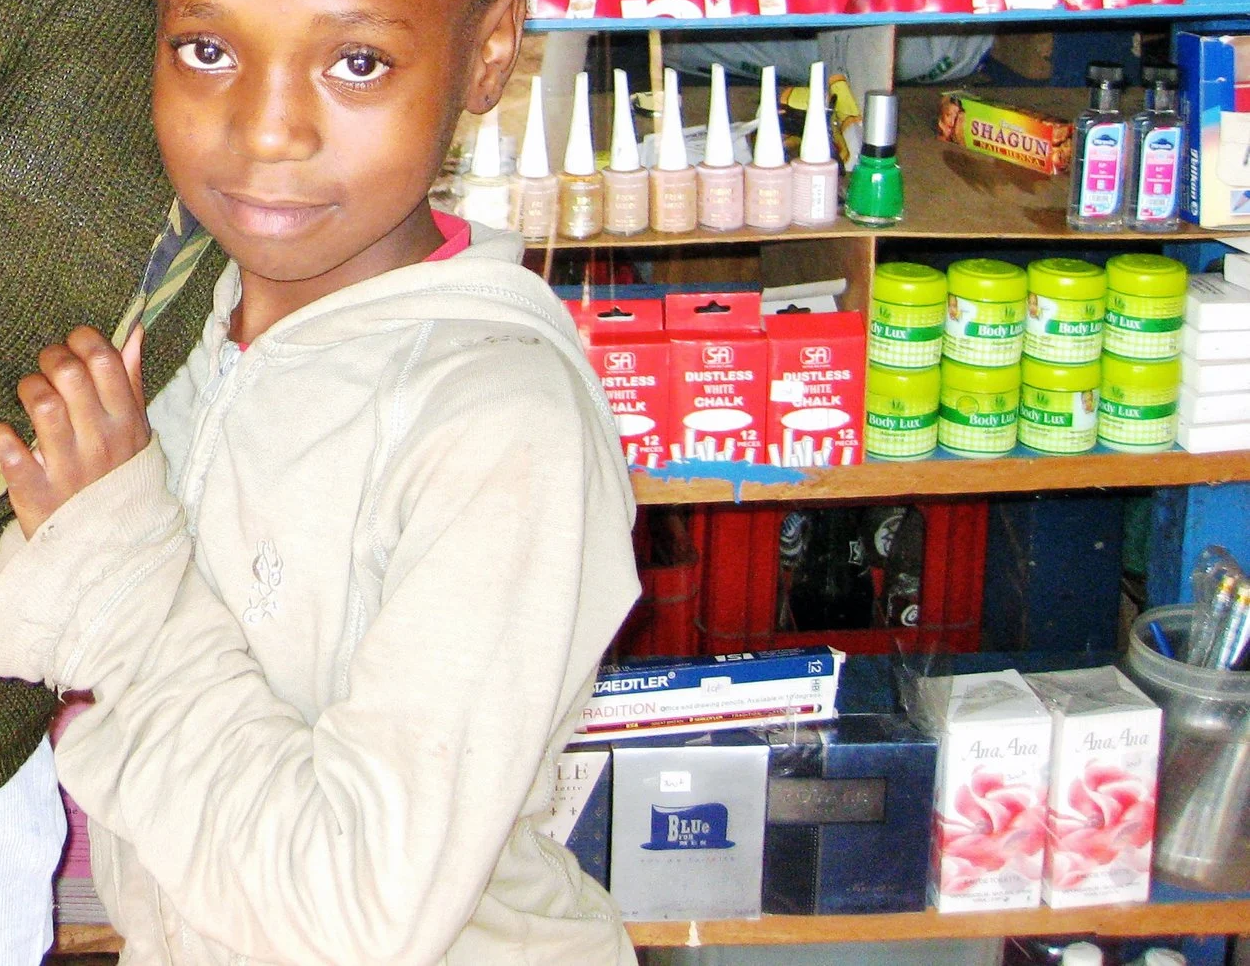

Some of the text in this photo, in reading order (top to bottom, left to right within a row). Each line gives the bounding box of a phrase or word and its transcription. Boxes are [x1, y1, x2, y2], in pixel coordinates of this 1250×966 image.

[971, 120, 1049, 156] SHAGUN
[1190, 148, 1199, 200] Pelikan
[1058, 321, 1102, 335] Body Lu
[1119, 315, 1142, 330] Lux
[885, 327, 907, 339] Lux
[978, 324, 1006, 338] Body
[609, 353, 631, 370] SA
[706, 346, 729, 364] SA
[804, 346, 828, 364] SA
[602, 375, 655, 387] STLESS
[685, 370, 754, 383] DUSTLESS
[783, 369, 851, 382] DUSTLESS
[703, 384, 735, 395] WHITE
[611, 401, 646, 413] HALK
[693, 395, 744, 408] CHALK
[1043, 412, 1066, 425] Lux
[1118, 406, 1142, 419] Lux
[868, 414, 922, 430] Body Lux
[969, 414, 998, 427] Body
[642, 435, 660, 446] 12
[740, 429, 757, 441] 12
[837, 428, 855, 440] 12
[592, 674, 671, 694] TAEDTLER
[582, 702, 657, 721] RADITION
[1076, 727, 1149, 753] Ana Ana
[963, 737, 1038, 761] Ana Ana
